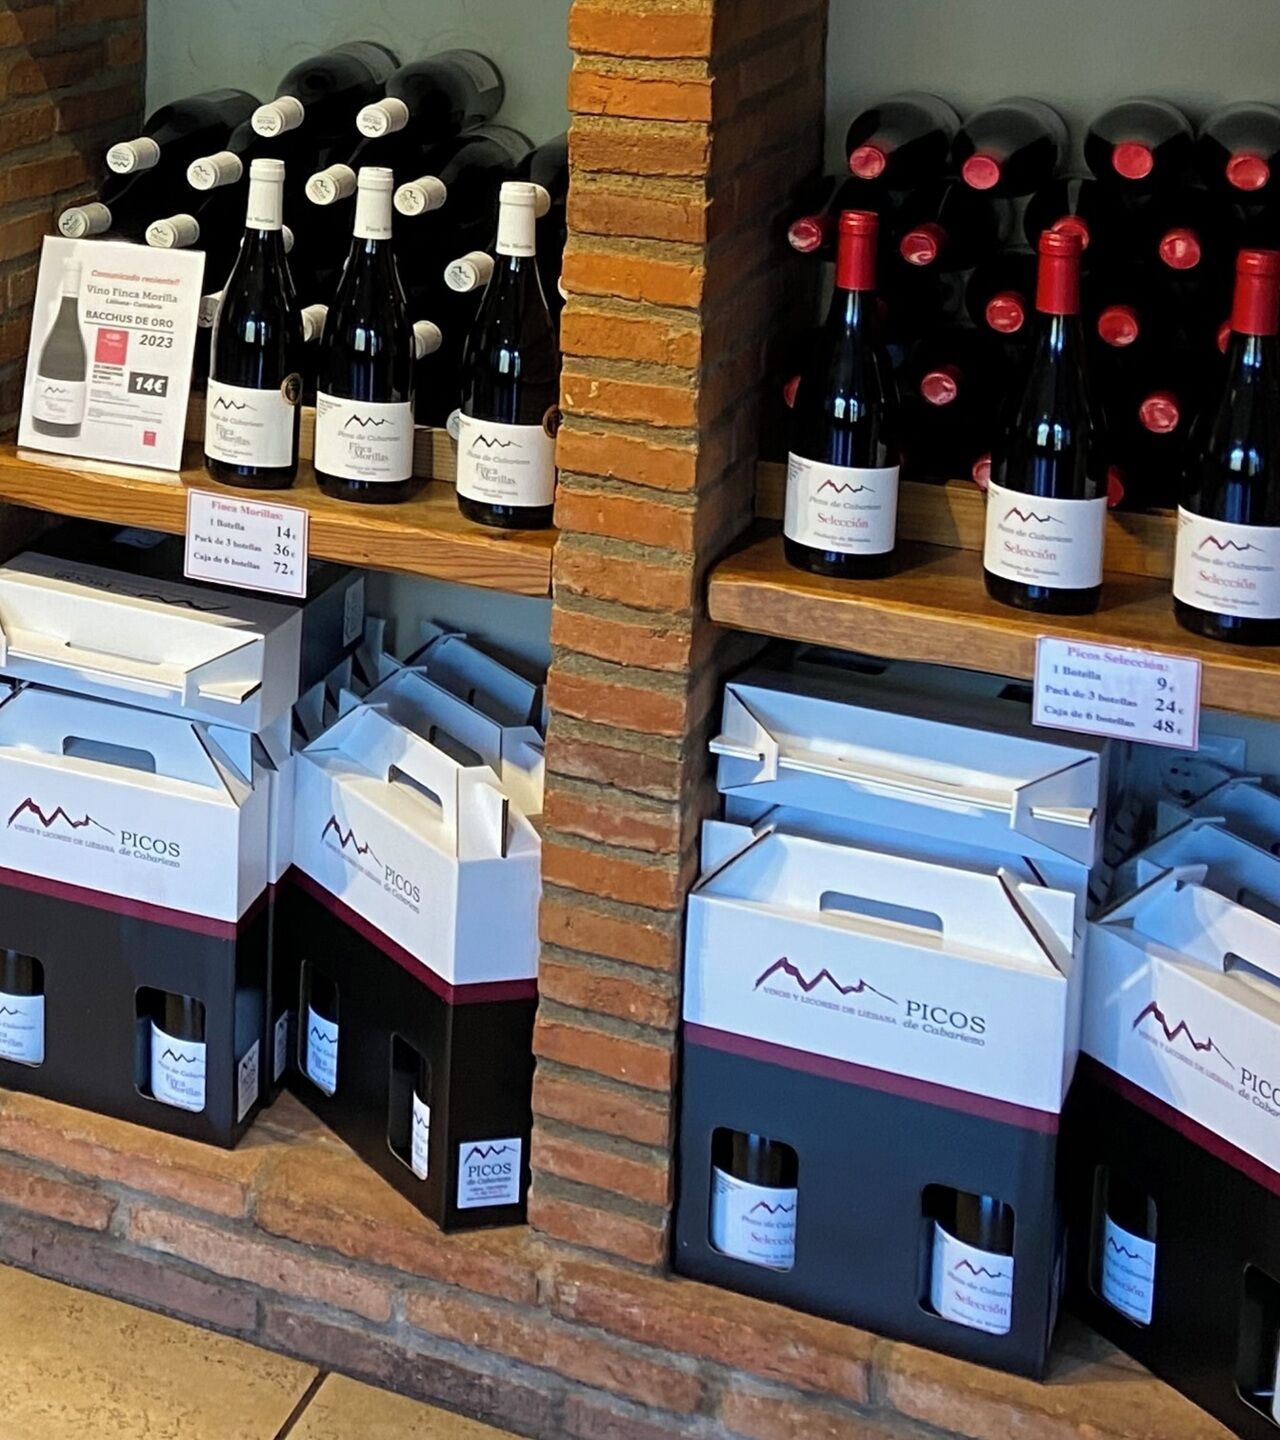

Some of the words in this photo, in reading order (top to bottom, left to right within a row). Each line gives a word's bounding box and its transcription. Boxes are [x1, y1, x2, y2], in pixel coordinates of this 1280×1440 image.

[87, 284, 110, 296] Vino
[112, 287, 139, 299] Finca
[143, 291, 178, 303] Morilla
[86, 310, 132, 324] BACCHUS
[135, 316, 148, 326] DE
[151, 318, 173, 328] ORO
[139, 334, 173, 349] 2023
[135, 376, 166, 393] 14€
[211, 501, 237, 512] Finca
[240, 505, 283, 520] Morillas:
[217, 519, 245, 531] Botella
[816, 510, 869, 531] Selección
[195, 534, 212, 544] Pack
[226, 538, 231, 546] 3
[233, 540, 262, 552] botellas
[194, 552, 211, 561] Caja
[213, 555, 222, 563] de
[232, 558, 260, 569] botellas
[1067, 646, 1101, 660] Picos
[1104, 652, 1169, 672] Selección:
[1063, 666, 1102, 681] Botella
[1045, 685, 1070, 697] Pack
[1073, 690, 1084, 699] de
[1088, 691, 1095, 700] 3
[1098, 693, 1138, 708] botellas
[1044, 705, 1068, 717] Caja
[1071, 710, 1083, 720] de
[1086, 711, 1093, 720] 6
[1096, 713, 1136, 728] botellas
[121, 830, 181, 857] PICOS
[384, 865, 421, 904] PICOS
[906, 999, 987, 1035] PICOS
[467, 1161, 513, 1177] PICOS
